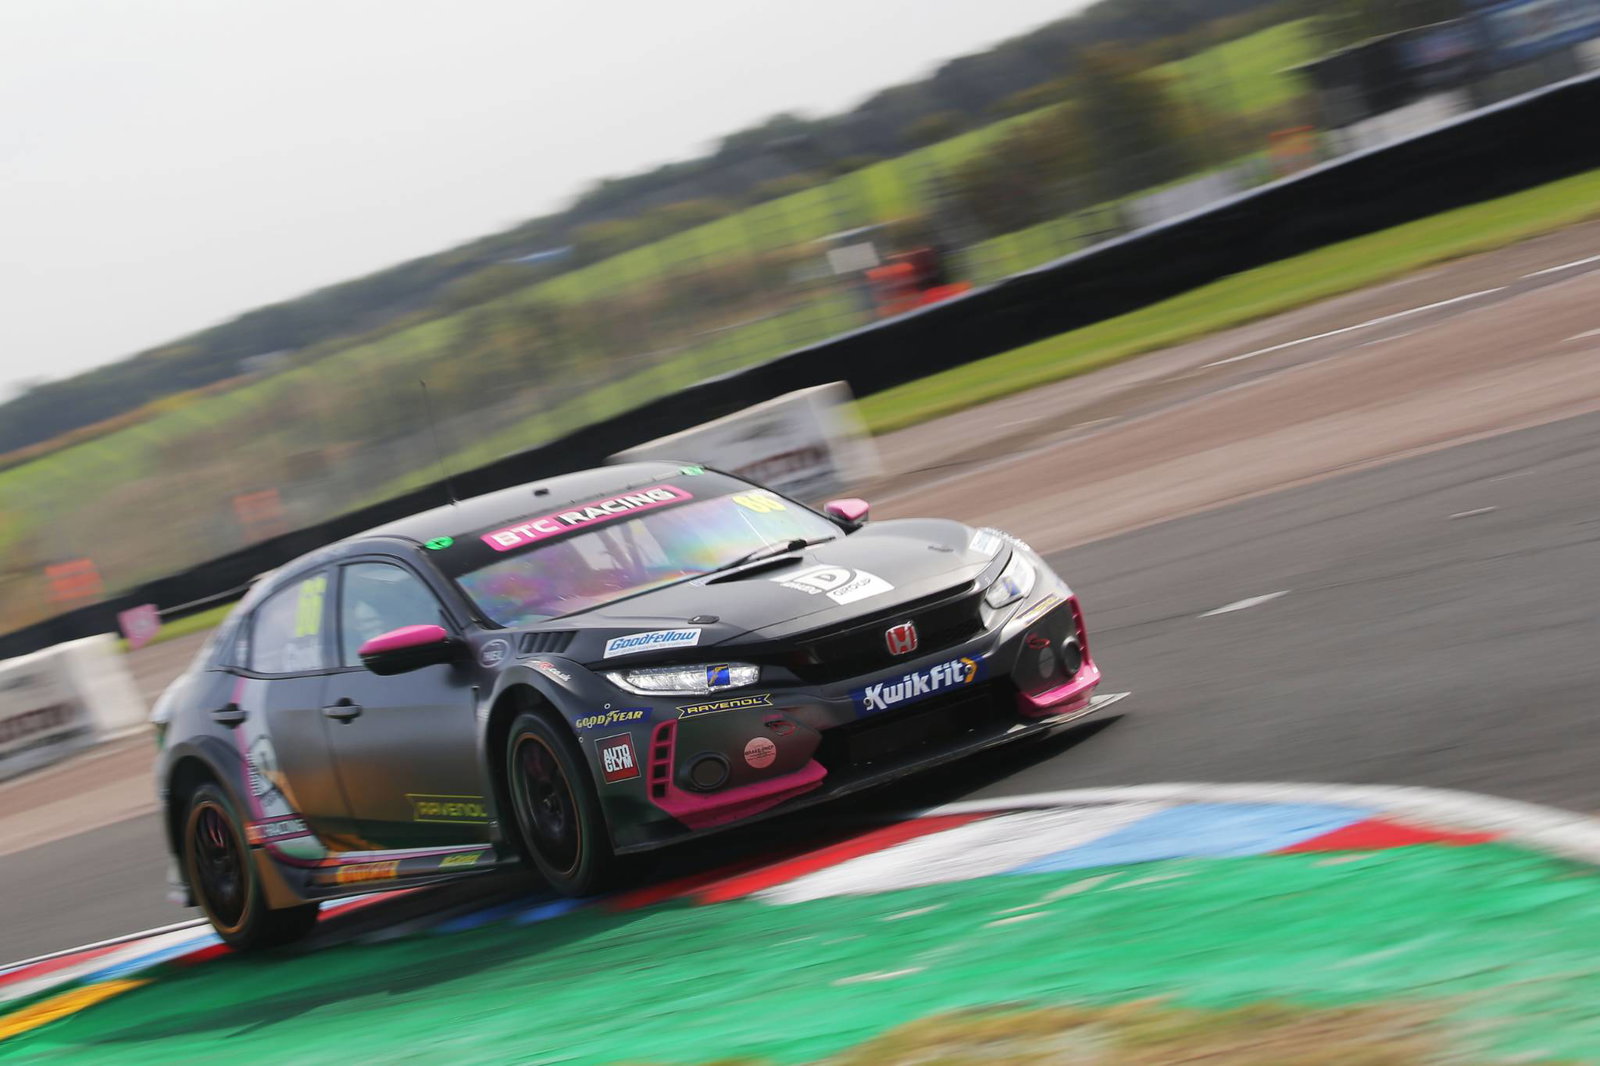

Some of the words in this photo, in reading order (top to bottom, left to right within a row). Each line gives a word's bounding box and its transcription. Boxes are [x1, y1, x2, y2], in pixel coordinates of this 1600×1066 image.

[491, 519, 560, 547] BTC
[558, 488, 677, 525] RACING
[608, 631, 697, 652] GoodFellow
[864, 659, 964, 711] KwikFit
[687, 698, 762, 714] RAVENOL
[575, 709, 643, 729] GOODYEAR
[603, 744, 630, 760] AUTO
[604, 756, 634, 773] GLYM
